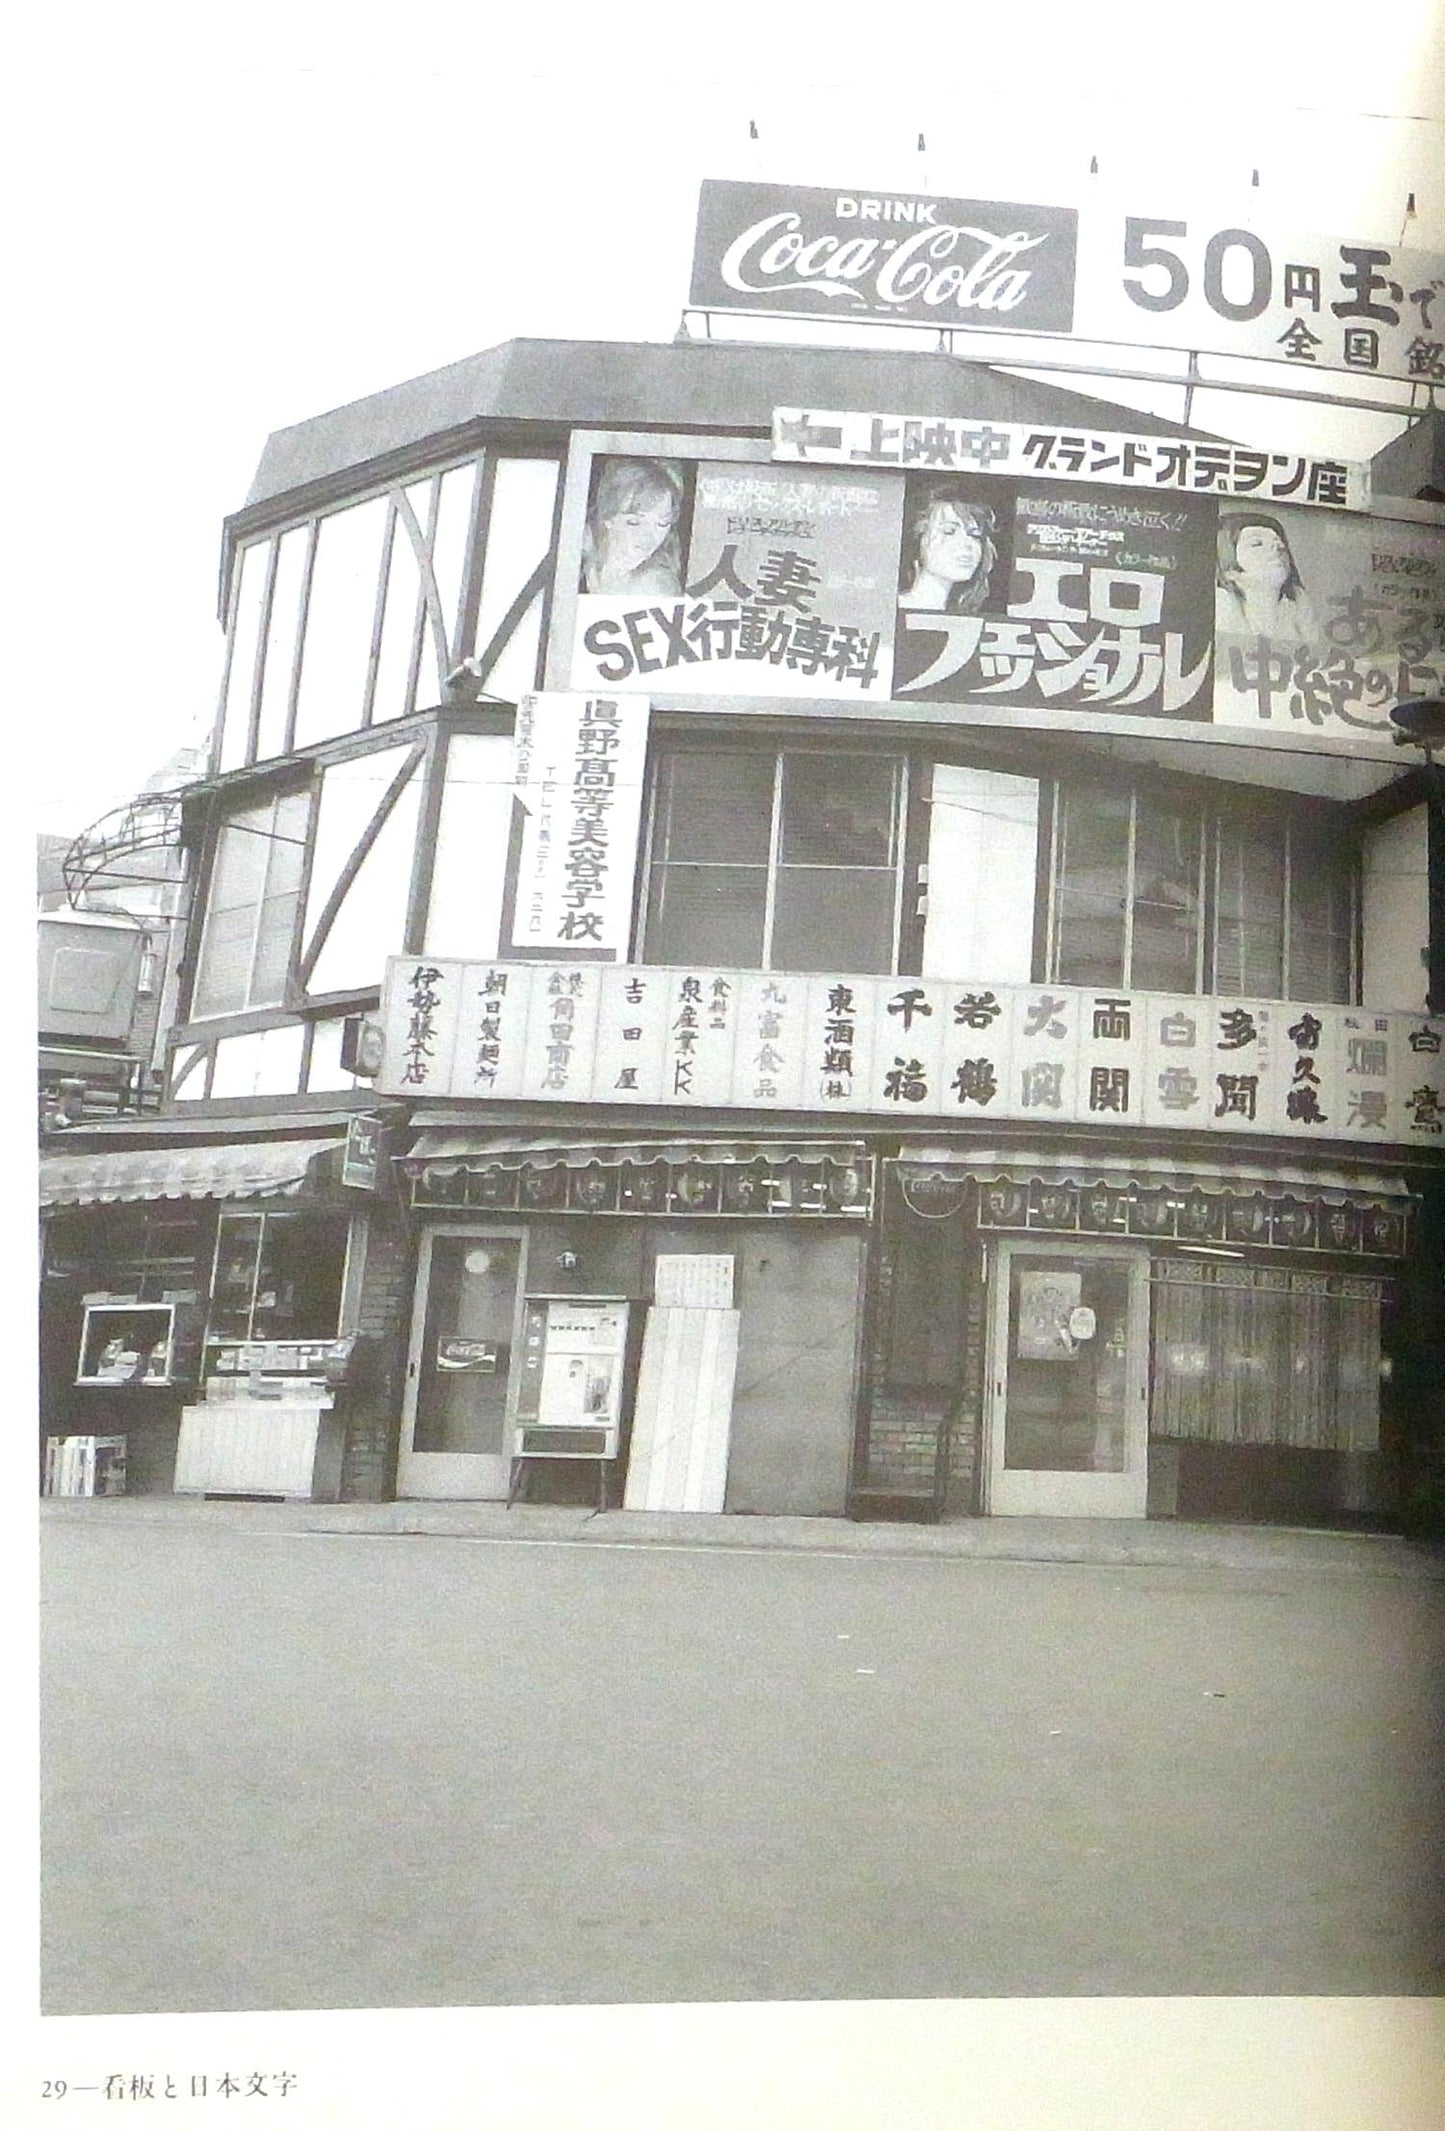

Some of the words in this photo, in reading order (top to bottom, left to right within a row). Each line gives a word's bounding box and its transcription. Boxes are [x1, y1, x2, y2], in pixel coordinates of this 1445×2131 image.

[835, 197, 938, 224] DRINK
[721, 210, 1051, 314] Coca-Cola
[1022, 434, 1349, 506] グランドオデヲン座
[686, 544, 822, 613] 人妻
[1006, 557, 1166, 628] エロ
[613, 977, 648, 1091] 吉田屋
[883, 987, 933, 1103] 千福
[1157, 1011, 1200, 1111] 白雪
[1214, 1007, 1260, 1122] 多聞
